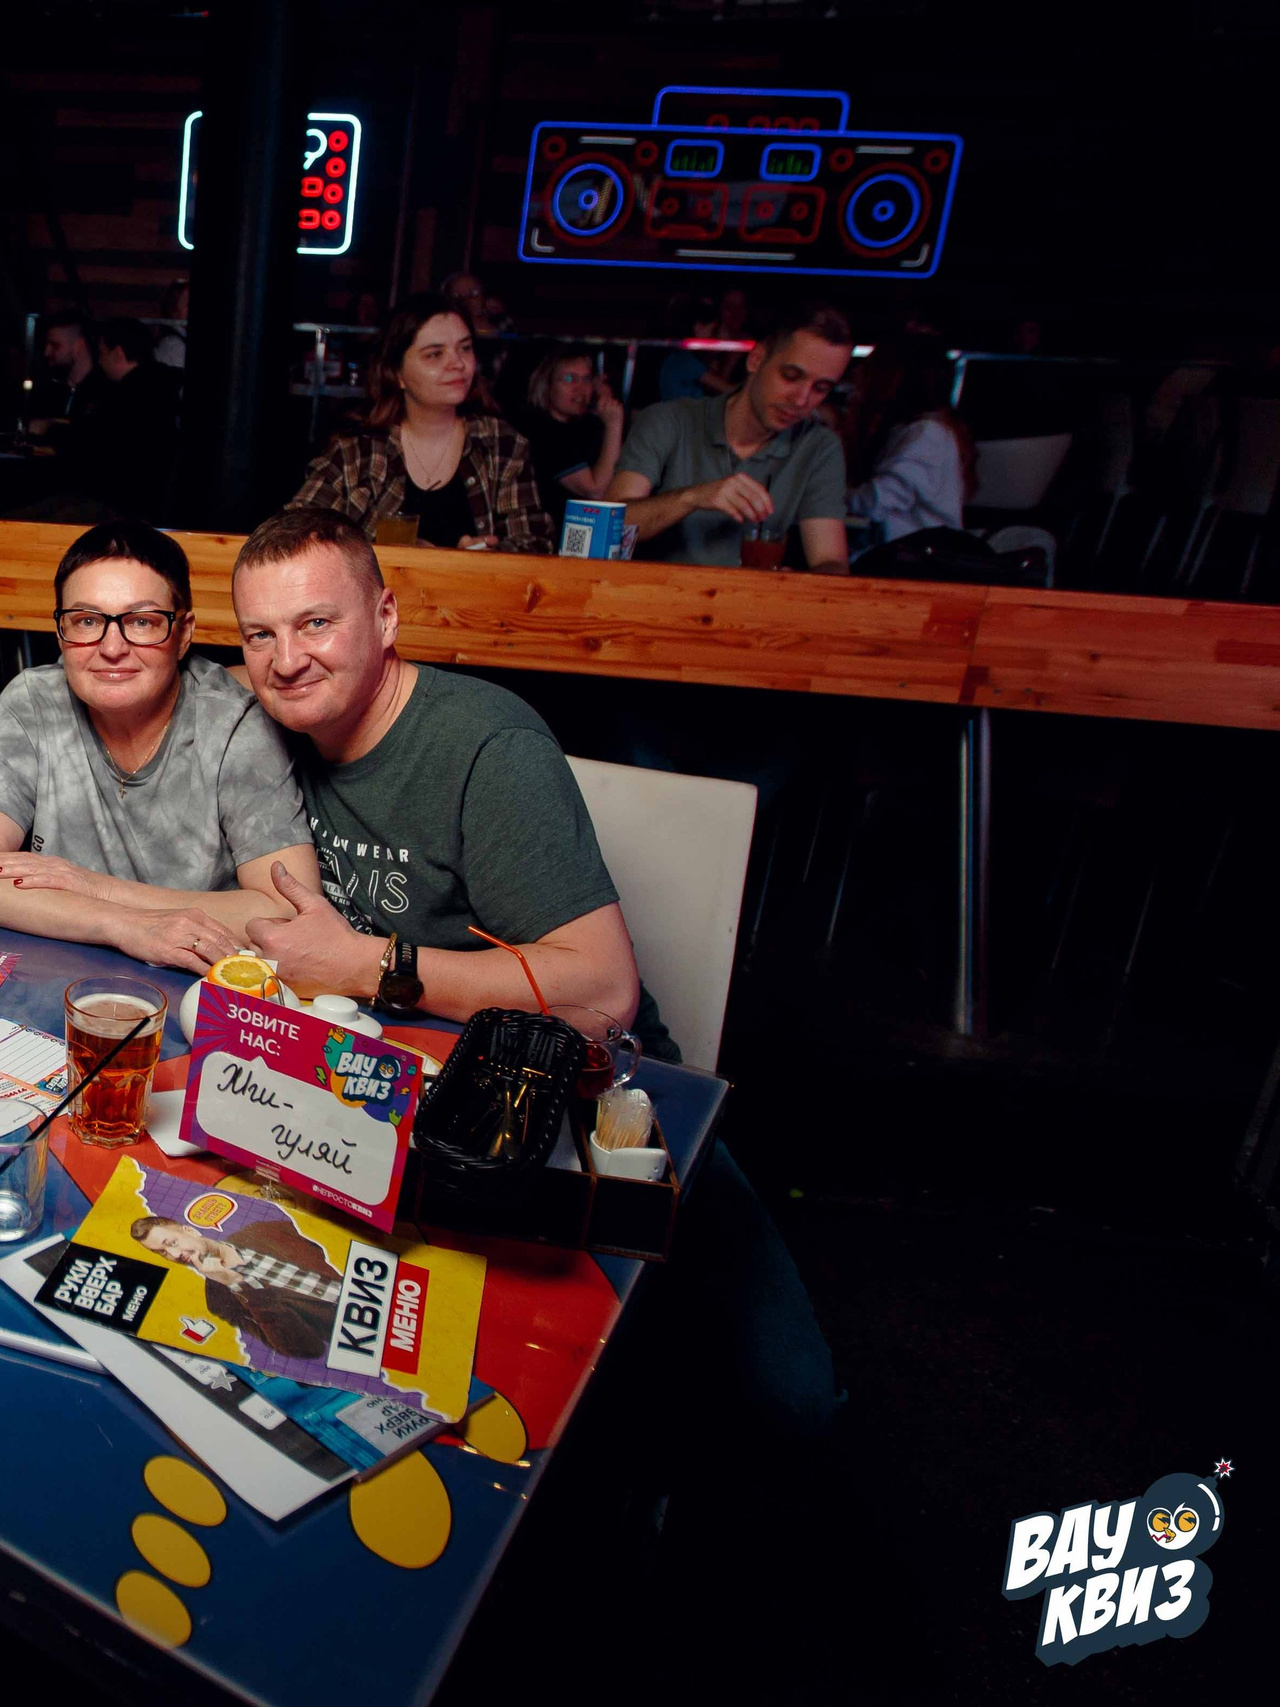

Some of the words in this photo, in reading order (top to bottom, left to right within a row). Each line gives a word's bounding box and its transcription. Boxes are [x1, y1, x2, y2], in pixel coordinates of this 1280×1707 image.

[357, 843, 409, 862] WEAR
[227, 1003, 301, 1041] ЗОВИТЕ
[239, 1029, 281, 1056] НАС:
[336, 1051, 378, 1077] ВАУ
[344, 1075, 392, 1100] КВИЗ
[271, 1124, 357, 1174] гуляй
[54, 1258, 93, 1304] РУКИ
[74, 1255, 118, 1311] ВВЕРХ
[94, 1280, 124, 1316] БАР
[122, 1285, 148, 1322] МЕНЮ
[337, 1256, 389, 1358] КВИЗ
[390, 1278, 421, 1353] МЕНЮ
